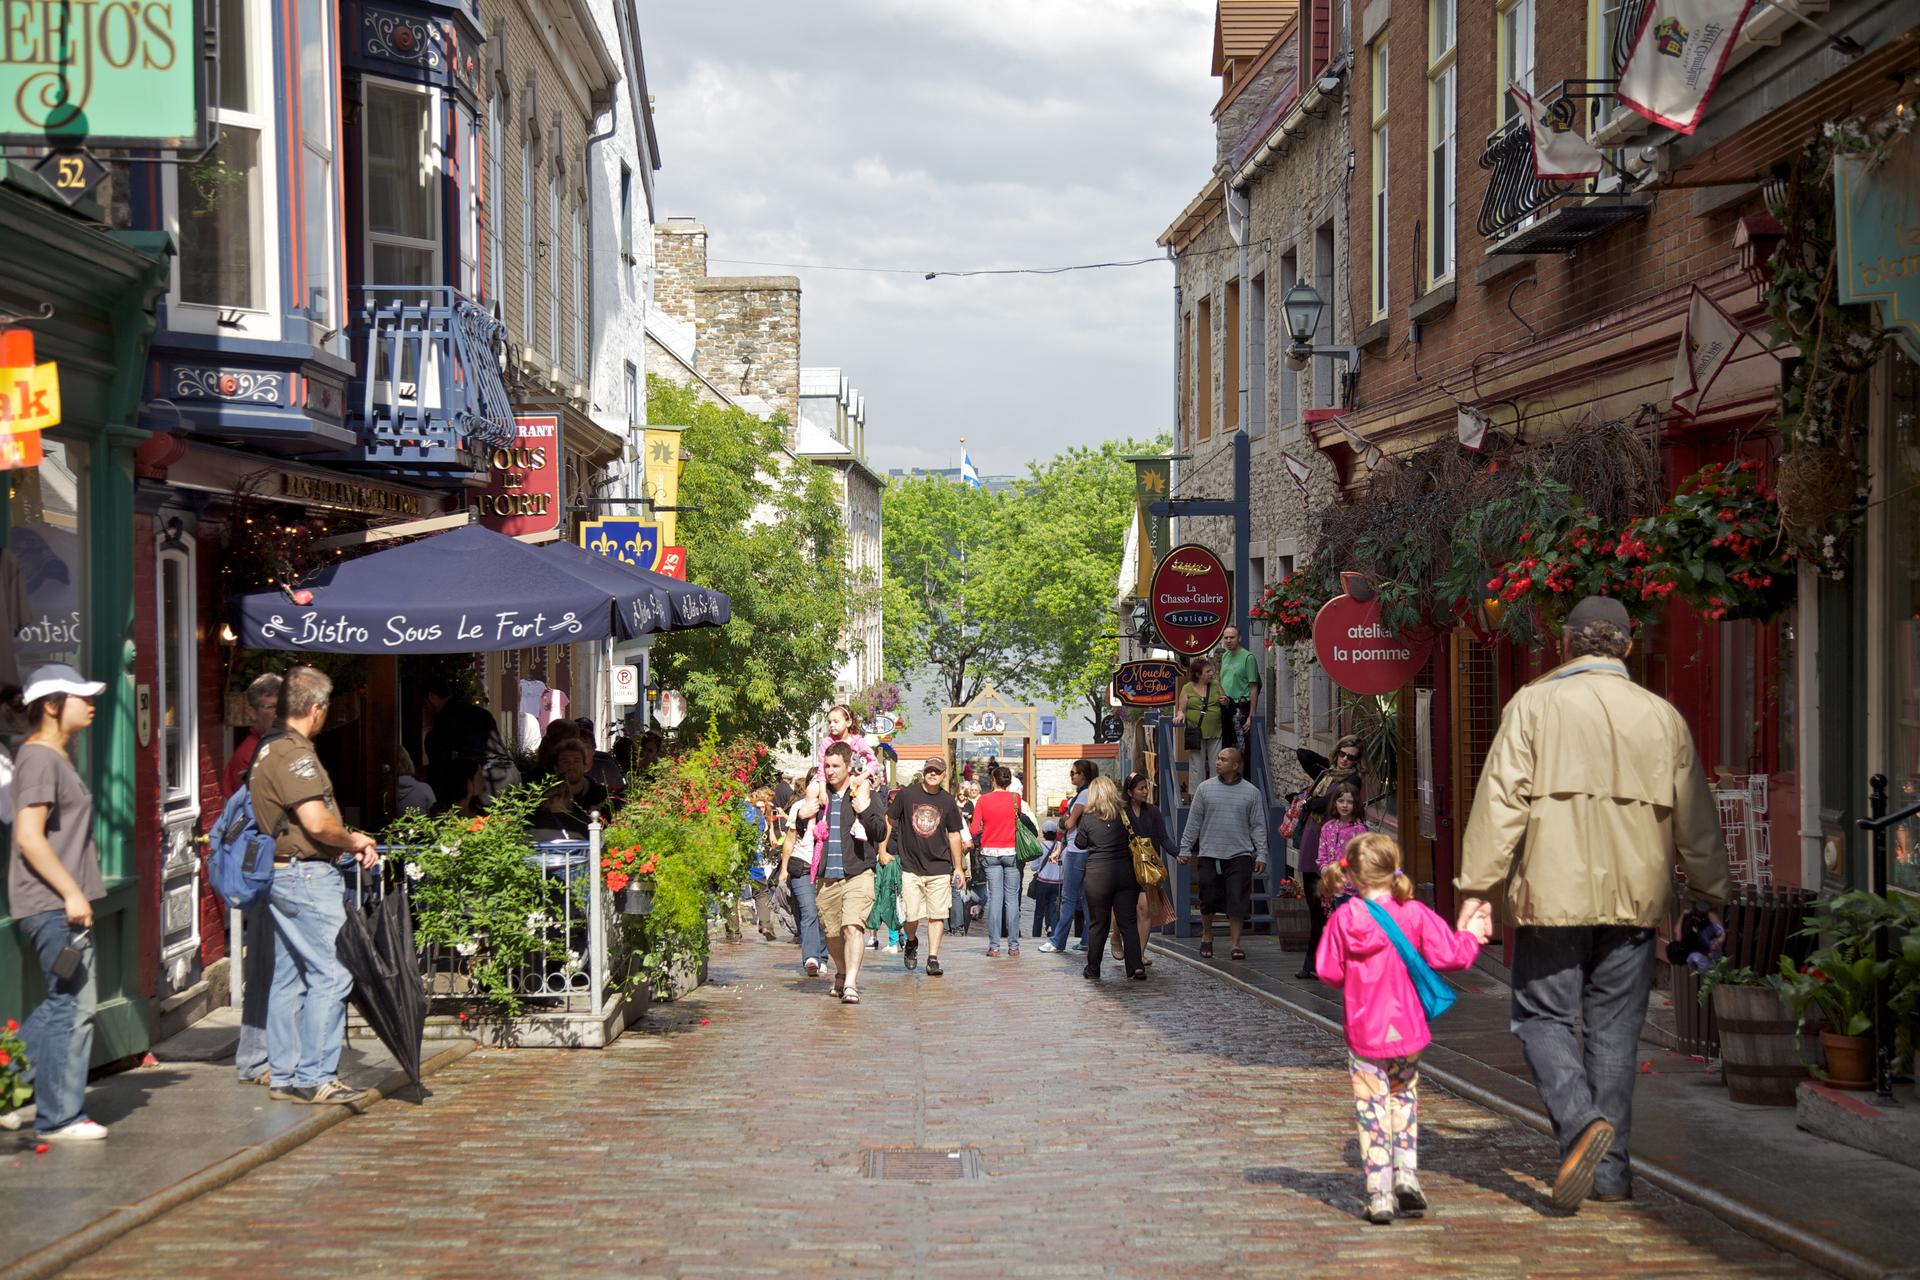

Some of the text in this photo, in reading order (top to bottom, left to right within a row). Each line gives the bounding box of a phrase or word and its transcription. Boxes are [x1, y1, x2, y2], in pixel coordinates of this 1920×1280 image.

[57, 158, 86, 188] 52
[516, 425, 555, 437] RANT
[486, 446, 547, 470] OUS
[502, 473, 524, 488] LE
[478, 492, 552, 516] FORT
[1186, 583, 1197, 593] La
[1160, 593, 1224, 604] Chasse-Galerie
[1172, 614, 1214, 623] Boutique
[292, 611, 544, 647] Bistro Sous Le Fort
[1333, 645, 1411, 664] la pomme
[1122, 663, 1172, 683] Mouche
[1144, 679, 1169, 693] Feu
